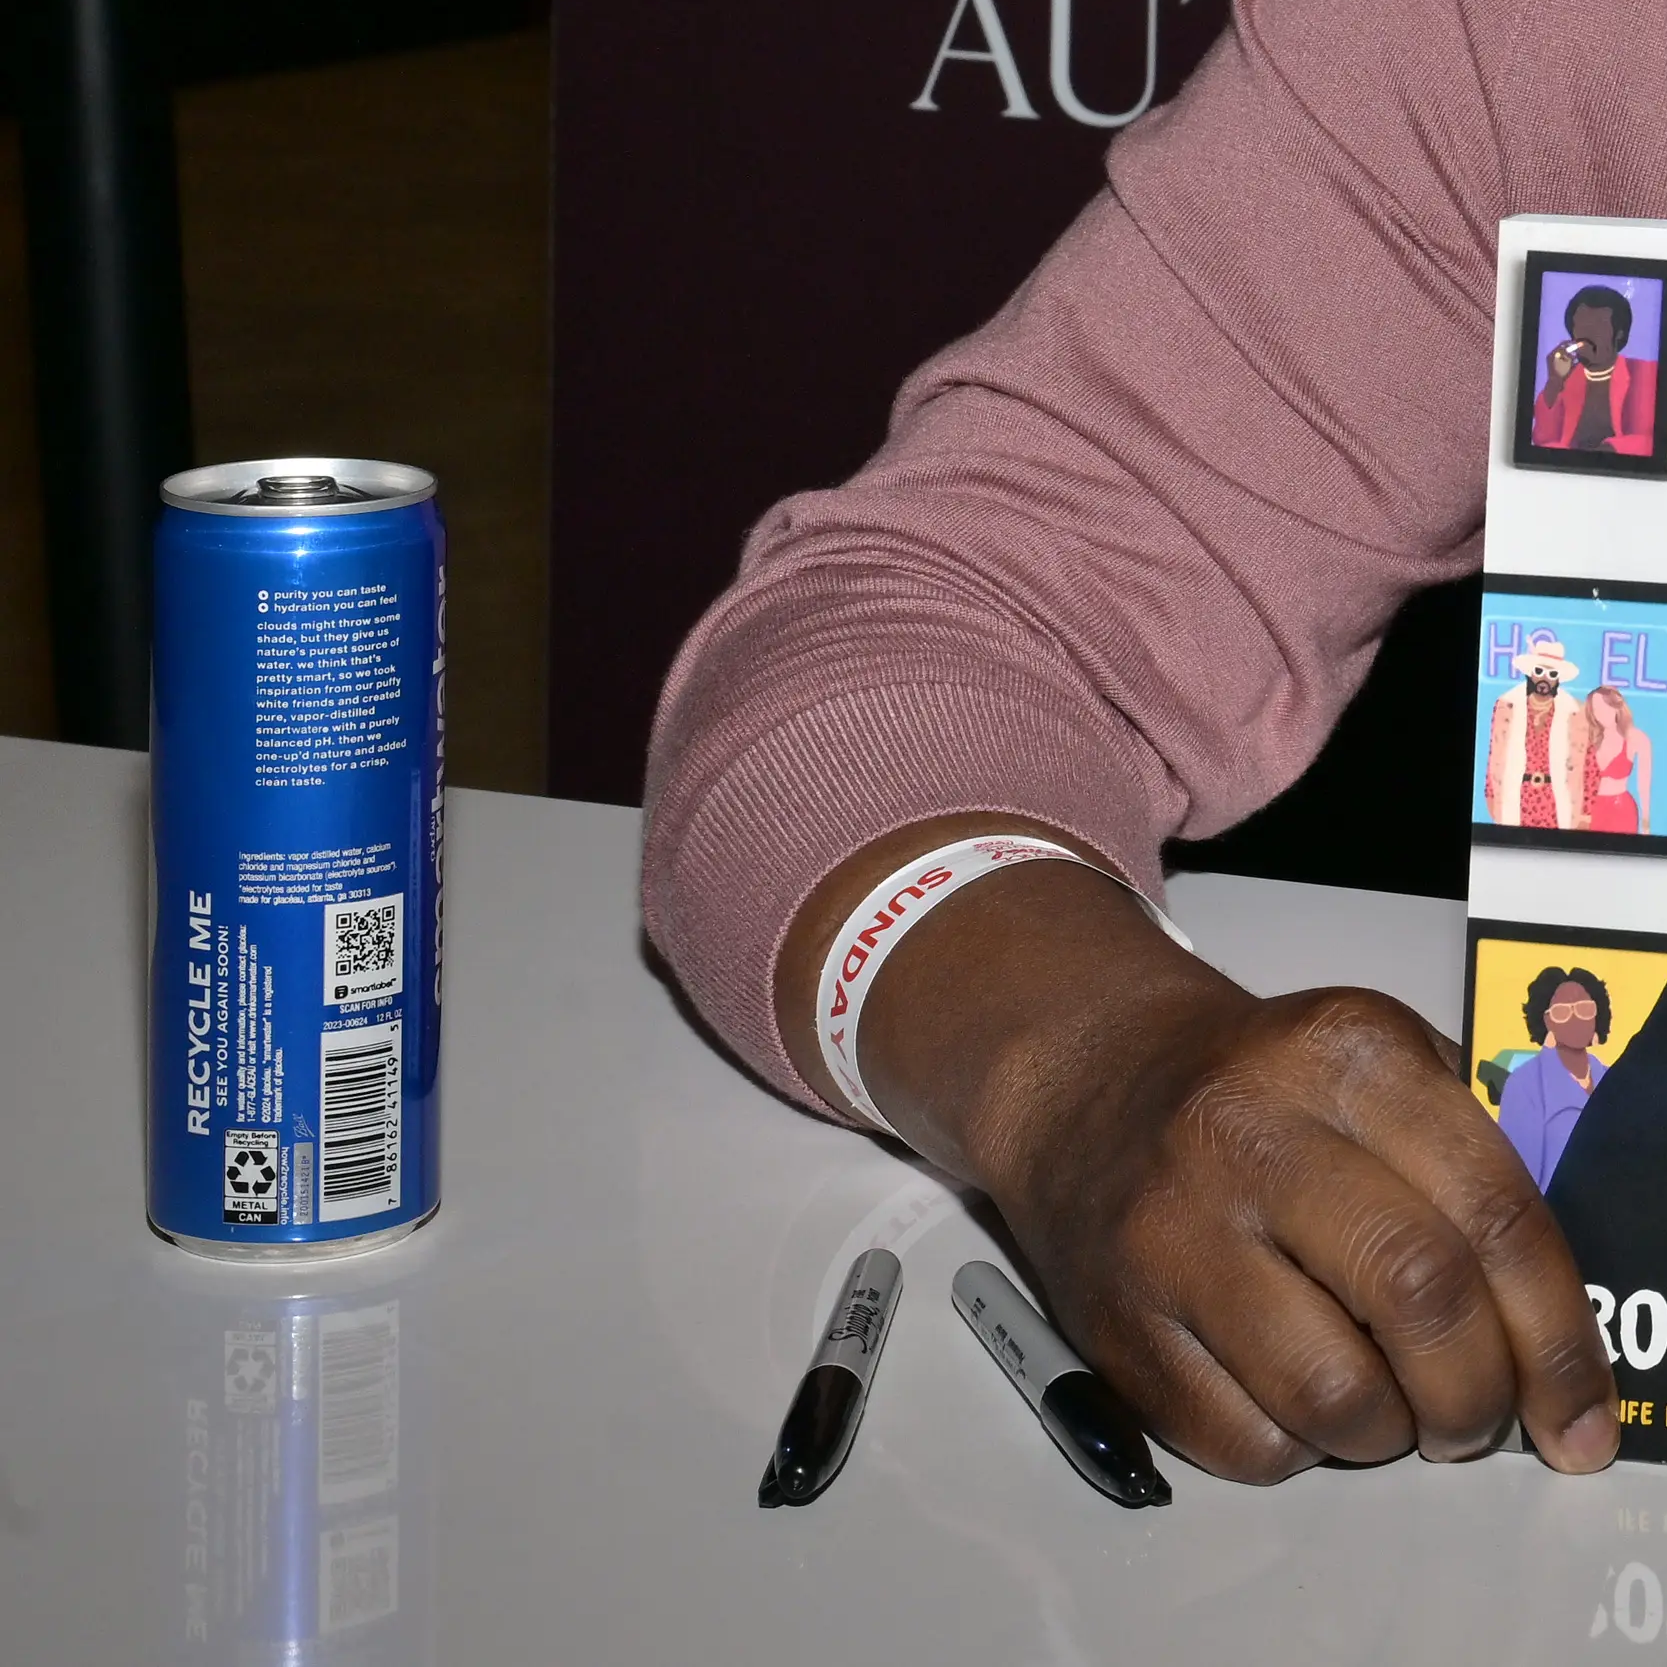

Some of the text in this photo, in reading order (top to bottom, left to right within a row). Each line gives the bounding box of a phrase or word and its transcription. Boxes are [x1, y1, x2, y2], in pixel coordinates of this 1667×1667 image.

[274, 584, 386, 600] purity you can taste
[274, 595, 397, 614] hydration you can feel
[257, 613, 400, 631] clouds might throw some
[257, 635, 296, 645] shade,
[301, 634, 320, 643] but
[324, 633, 348, 642] they
[352, 629, 374, 641] give
[257, 637, 400, 657] nature's purest source of
[257, 654, 381, 669] water. we think that's
[256, 665, 395, 684] pretty smart, so we took
[257, 677, 401, 697] inspiration from our puffy
[256, 689, 400, 708] white friends and created
[256, 706, 375, 723] pure, vapor-distilled
[332, 722, 356, 732] with
[369, 716, 400, 729] purely
[256, 733, 381, 748] balanced pH. then we
[256, 739, 406, 761] one-up'd nature and added
[256, 763, 327, 774] electrolytes
[331, 762, 347, 771] for
[360, 758, 389, 767] crisp,
[256, 777, 325, 786] clean taste.
[830, 866, 953, 1063] SUNDAY
[187, 890, 212, 1136] RECYCLE ME
[216, 925, 229, 1107] SEE YOU AGAIN SOON!
[280, 1147, 289, 1225] how2recycle.info
[233, 1201, 268, 1209] METAL
[239, 1213, 261, 1222] CAN
[1620, 1400, 1654, 1426] IFE
